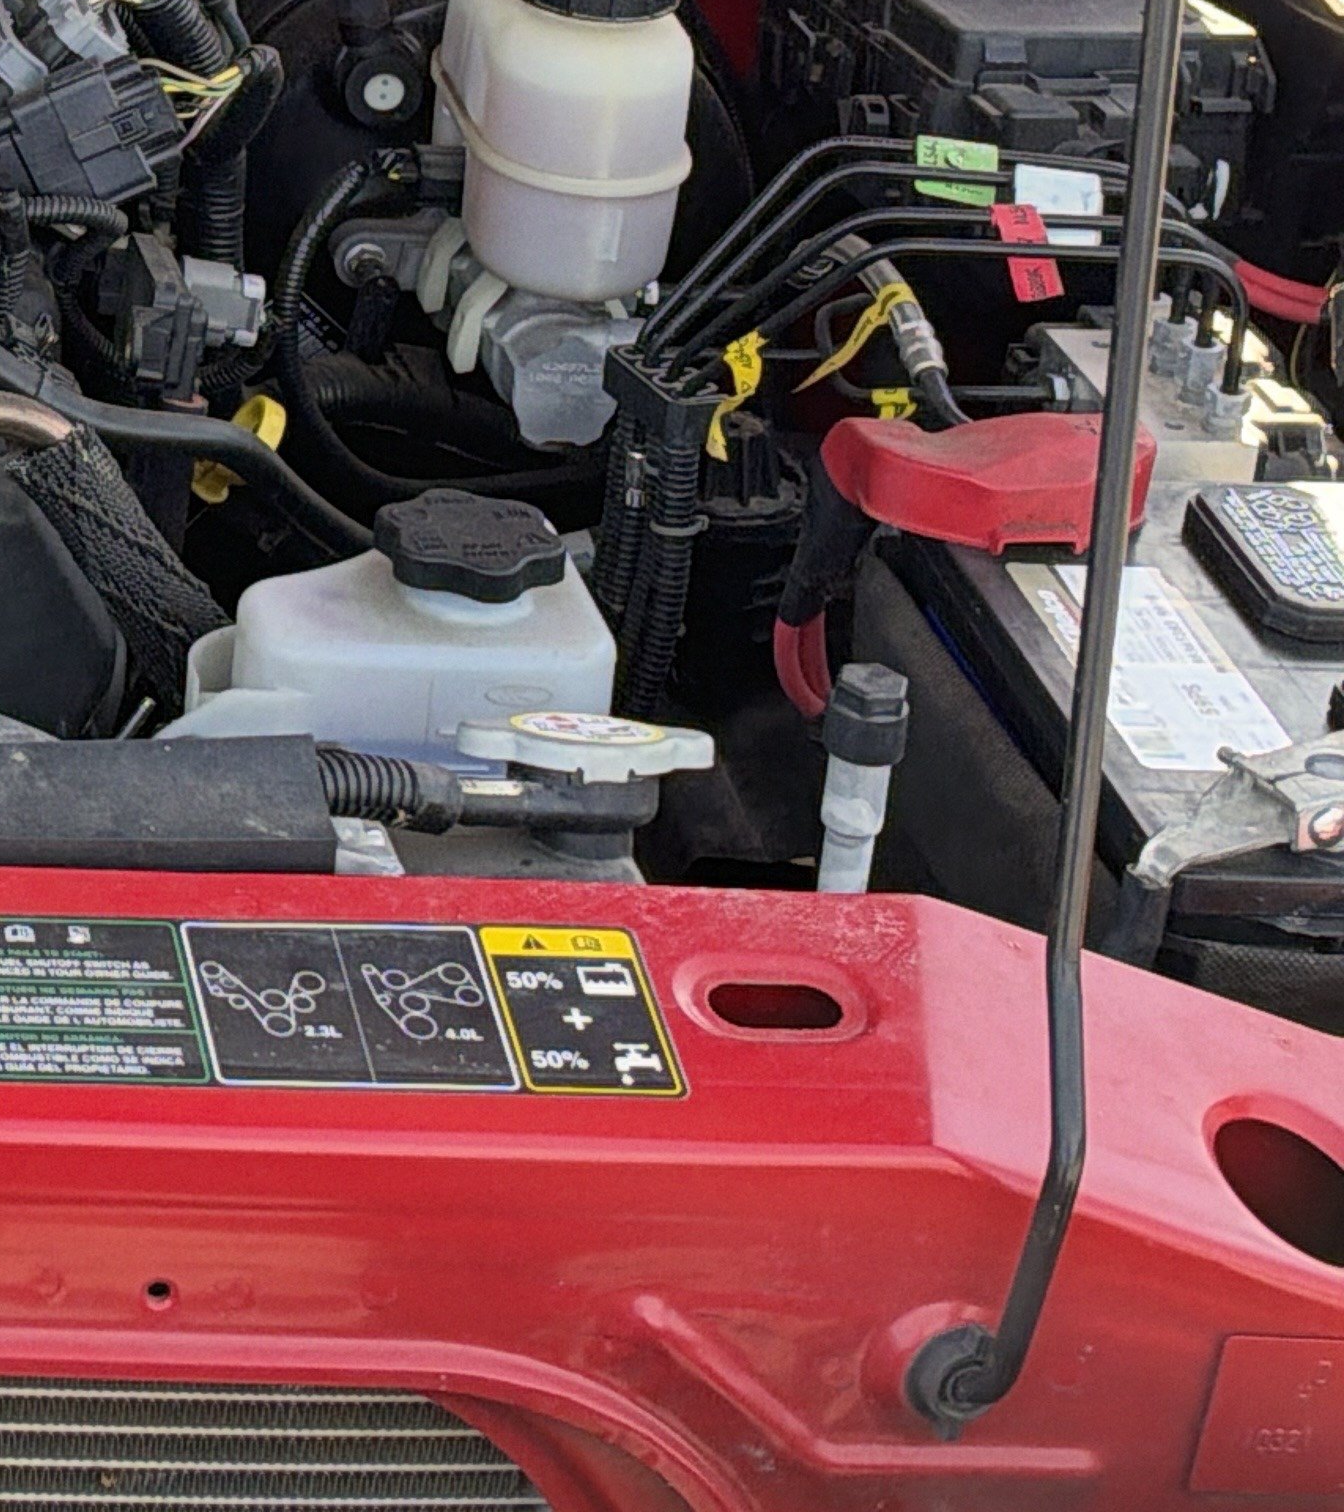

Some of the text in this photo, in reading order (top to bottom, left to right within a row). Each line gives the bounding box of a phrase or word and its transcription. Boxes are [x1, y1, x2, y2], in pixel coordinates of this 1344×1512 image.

[505, 971, 564, 990] 50%
[304, 1024, 343, 1039] 2.3L
[445, 1027, 484, 1042] 4.0L
[530, 1050, 591, 1070] 50%
